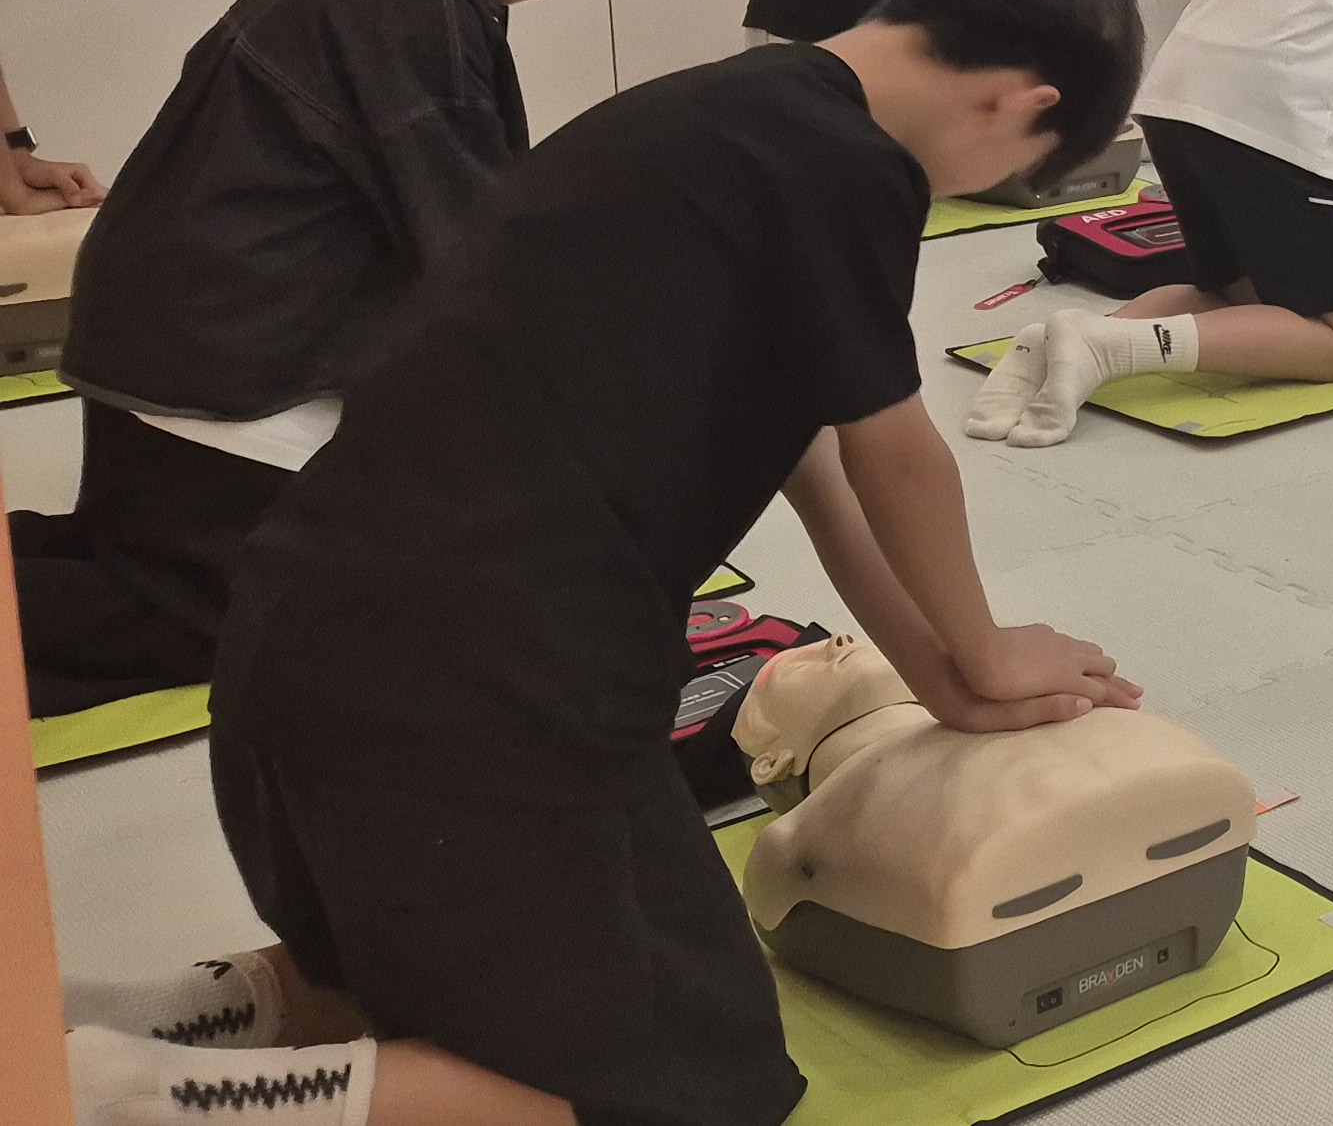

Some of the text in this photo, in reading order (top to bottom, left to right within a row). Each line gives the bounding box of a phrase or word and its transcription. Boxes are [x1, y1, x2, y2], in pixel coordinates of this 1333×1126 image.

[1081, 209, 1127, 223] AED
[1161, 328, 1172, 355] NIKE
[1079, 955, 1144, 994] BRAYDEN
